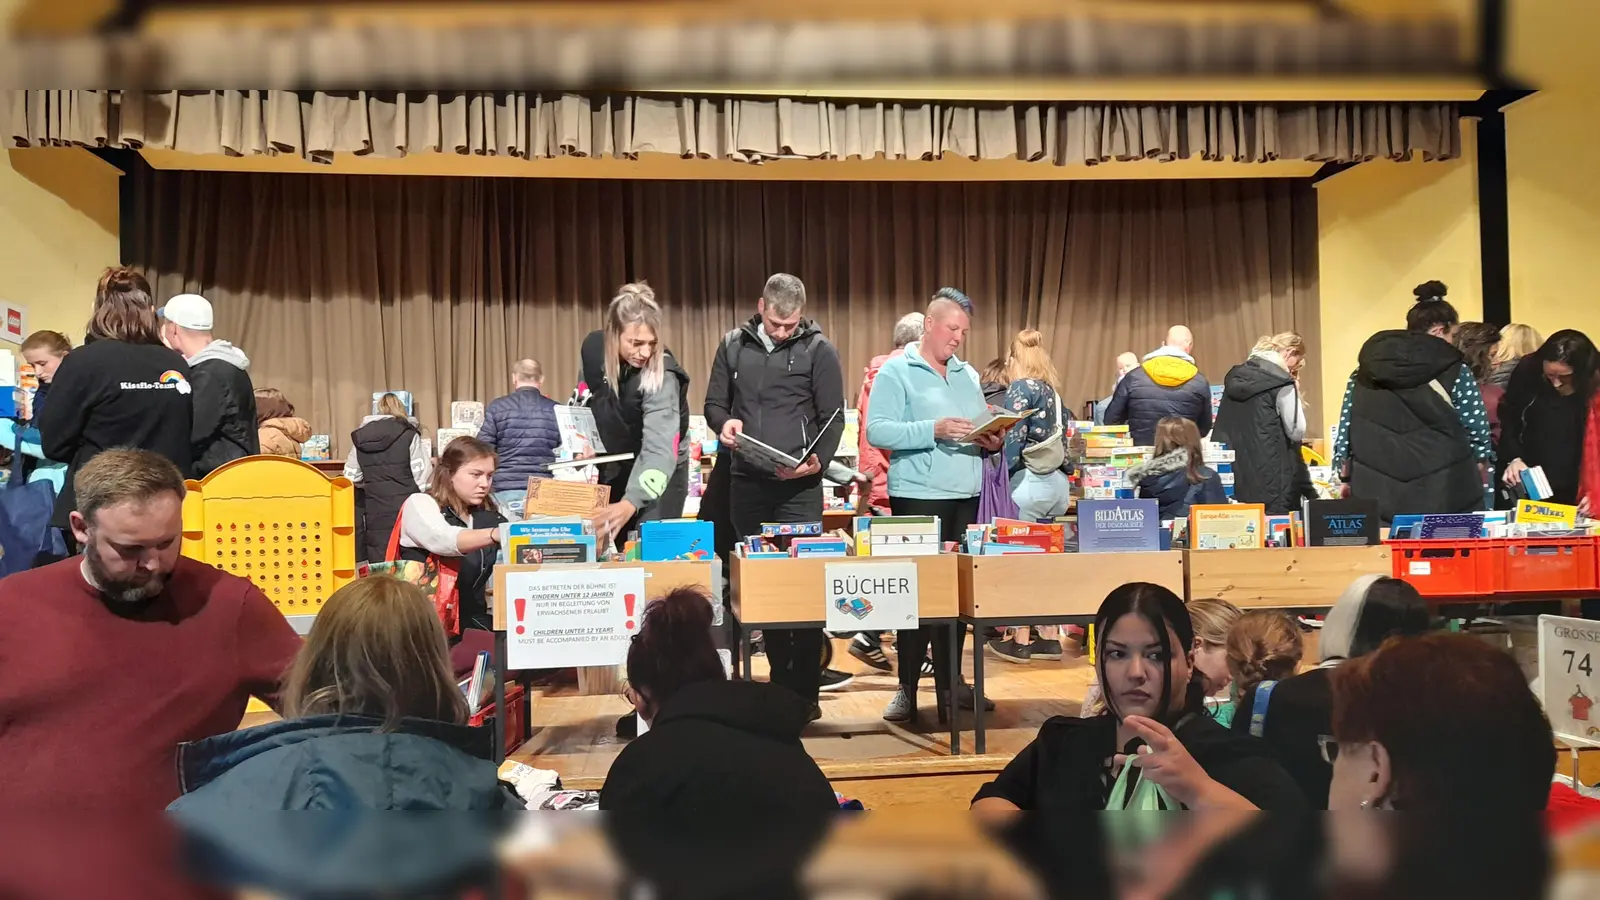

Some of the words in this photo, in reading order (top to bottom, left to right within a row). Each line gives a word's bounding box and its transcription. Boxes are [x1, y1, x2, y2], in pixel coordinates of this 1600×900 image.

[1095, 505, 1144, 521] BILDATLAS
[1328, 519, 1363, 529] ATLAS
[586, 582, 607, 590] BÜHNE
[833, 575, 910, 595] BÜCHER
[558, 599, 596, 607] BEGLEITUNG
[536, 609, 583, 617] ERWACHSENEN
[583, 607, 609, 615] ERLAUBT
[533, 628, 564, 636] CHILDREN
[595, 626, 615, 634] YEARS
[545, 635, 590, 643] ACCOMPANIED
[1562, 649, 1593, 678] 74
